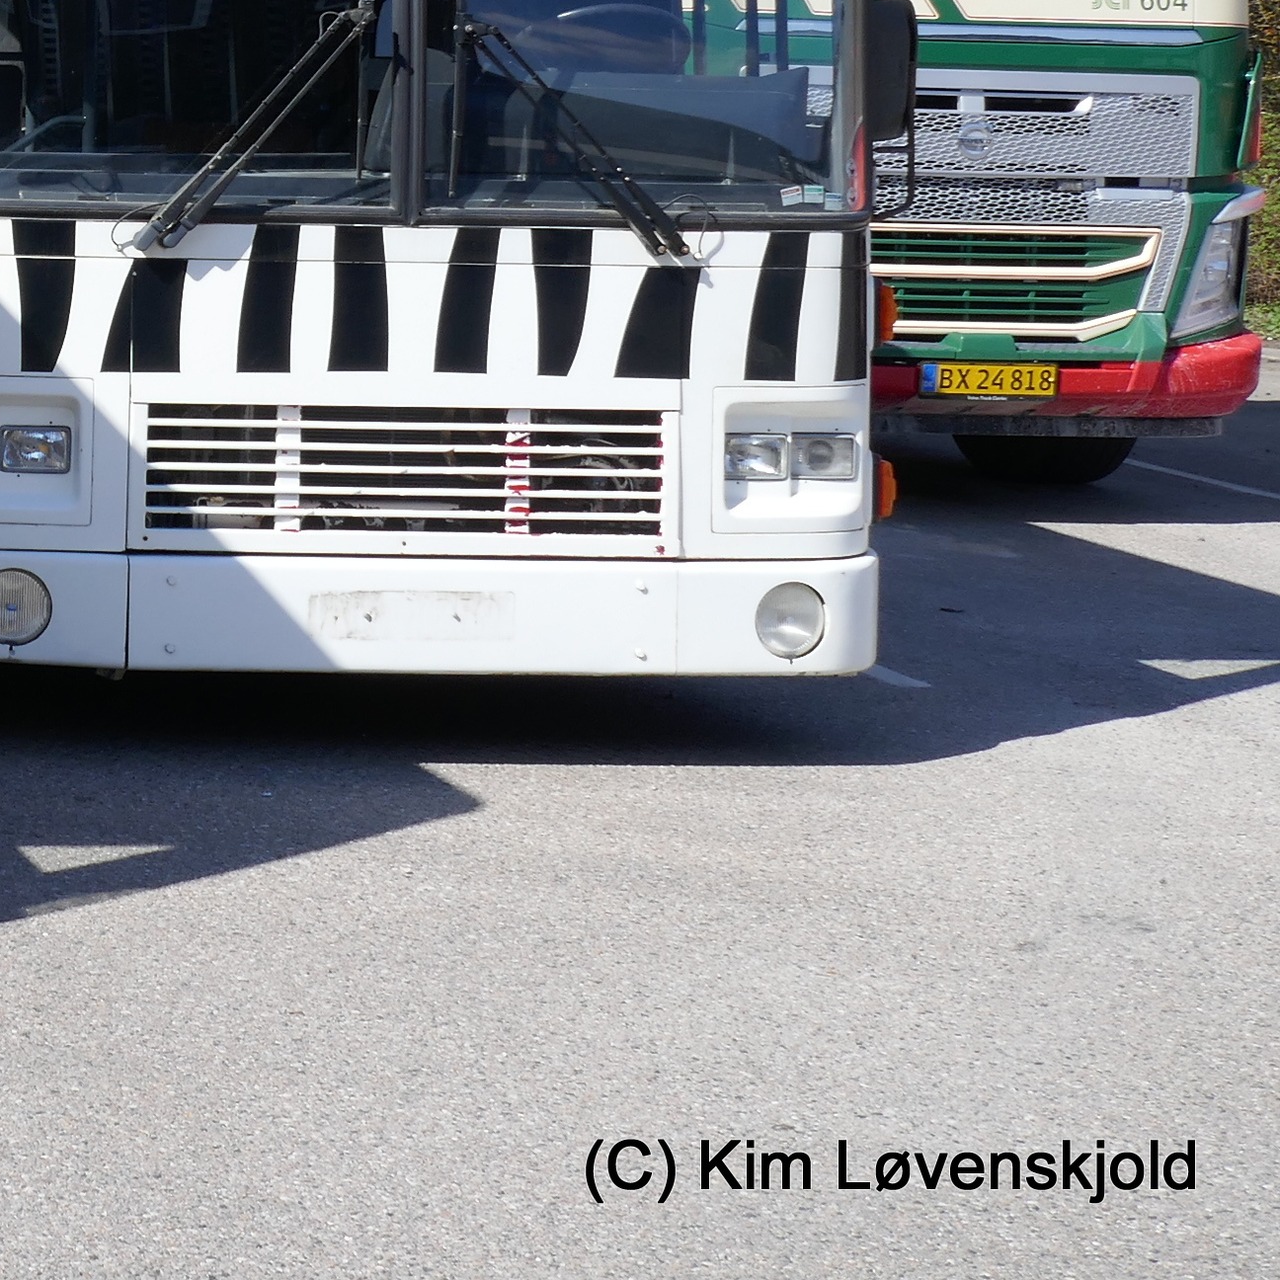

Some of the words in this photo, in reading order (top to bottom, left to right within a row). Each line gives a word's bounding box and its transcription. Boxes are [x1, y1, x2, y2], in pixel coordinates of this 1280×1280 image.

[940, 368, 970, 390] BX
[976, 369, 1004, 390] 24
[1010, 369, 1052, 391] 818
